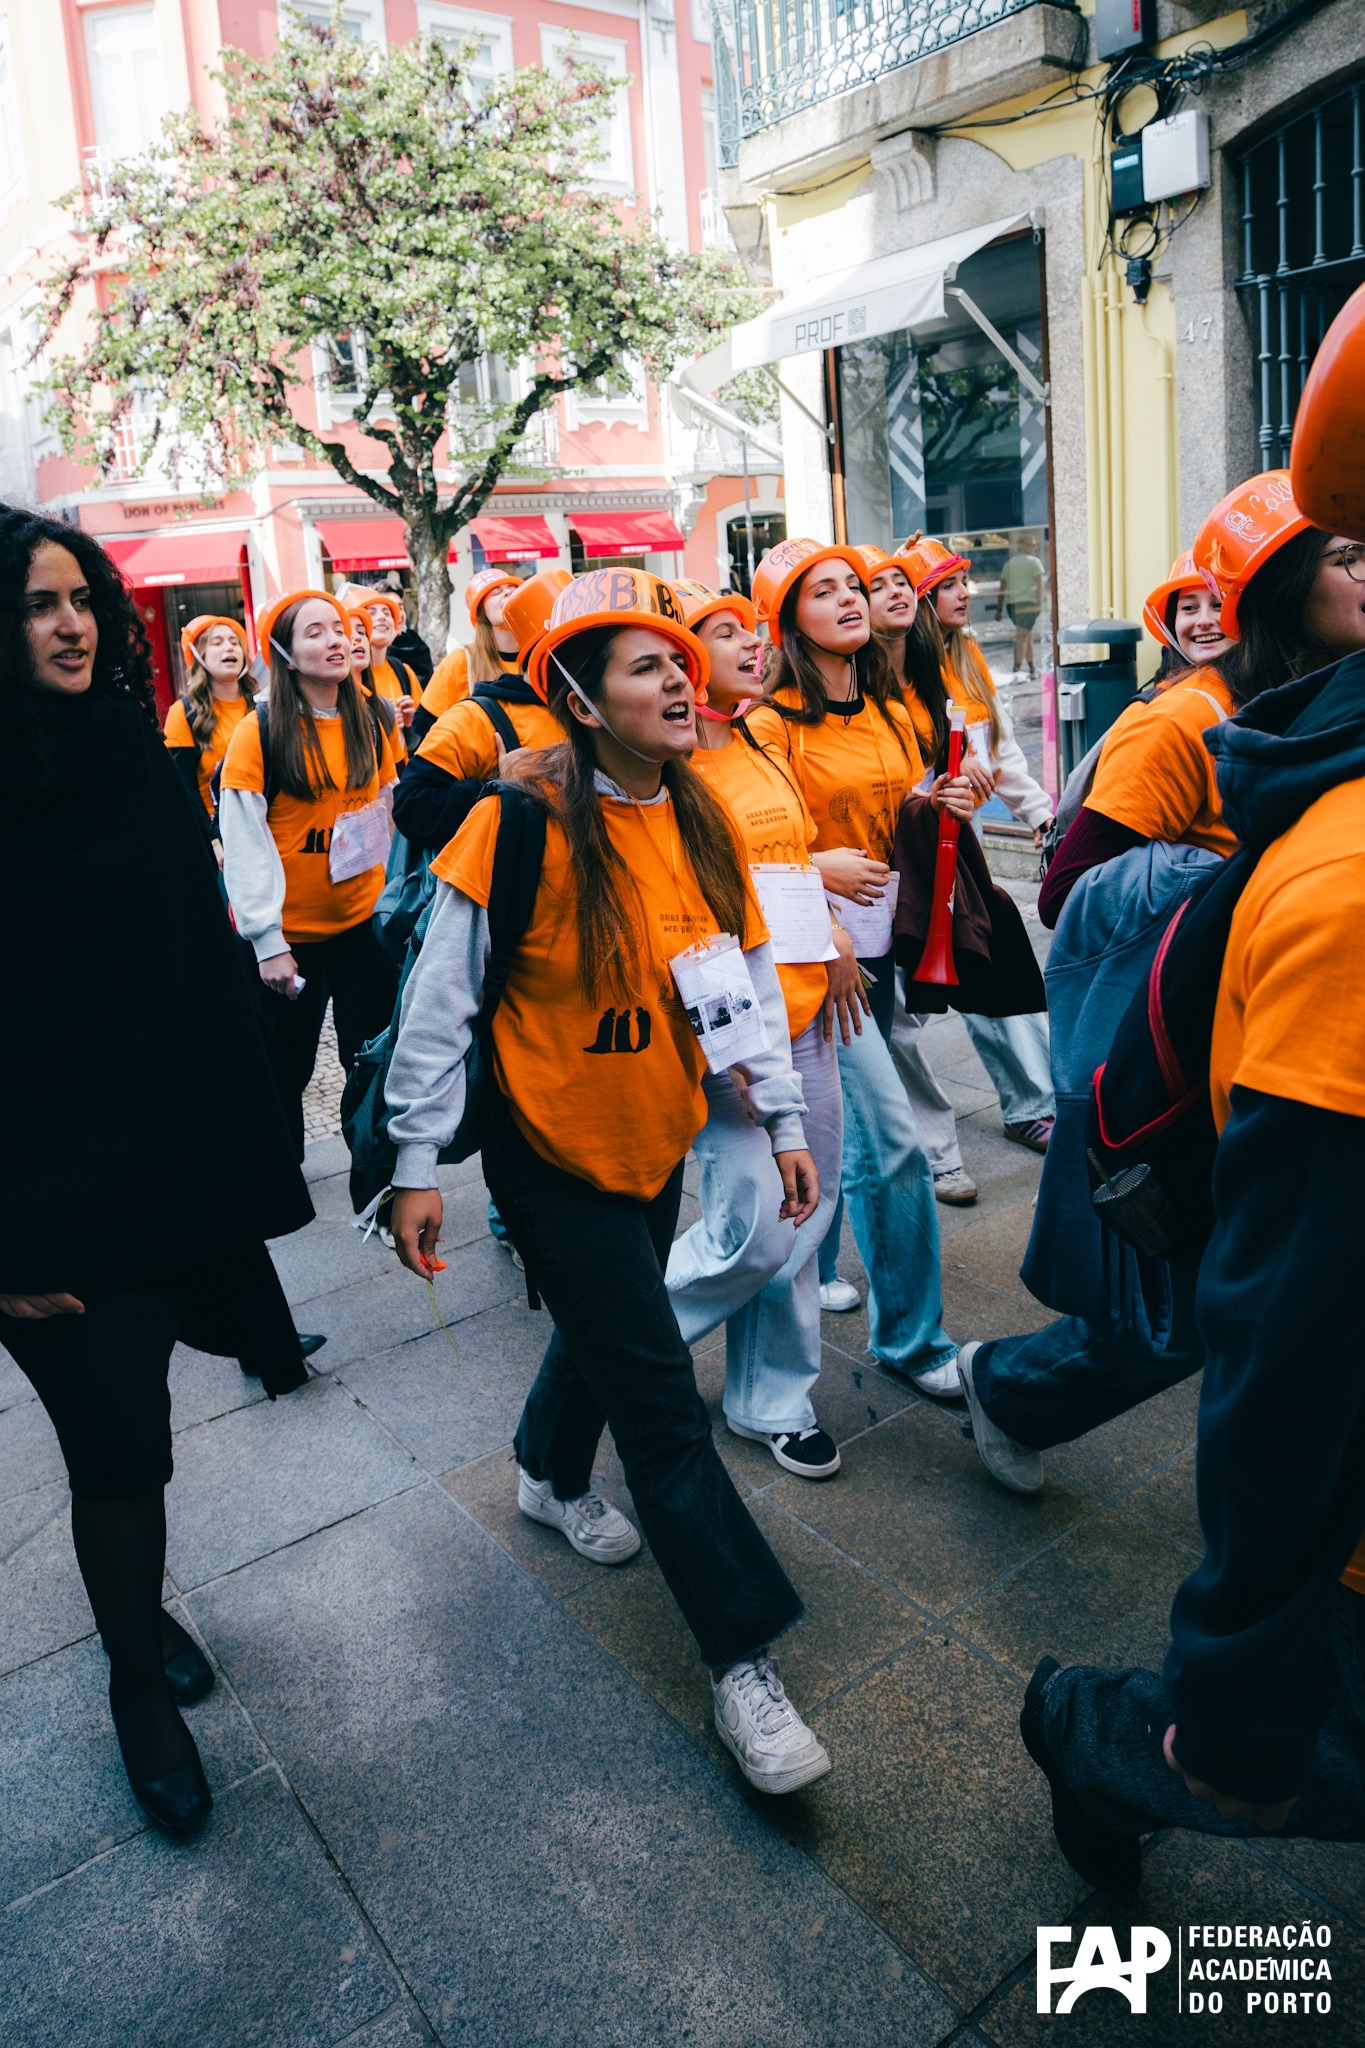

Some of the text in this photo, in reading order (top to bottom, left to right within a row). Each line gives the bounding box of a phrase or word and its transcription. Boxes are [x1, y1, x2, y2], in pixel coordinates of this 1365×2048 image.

[796, 312, 845, 349] PROF
[1182, 317, 1214, 343] 47
[123, 508, 150, 518] LION
[154, 505, 169, 514] OF
